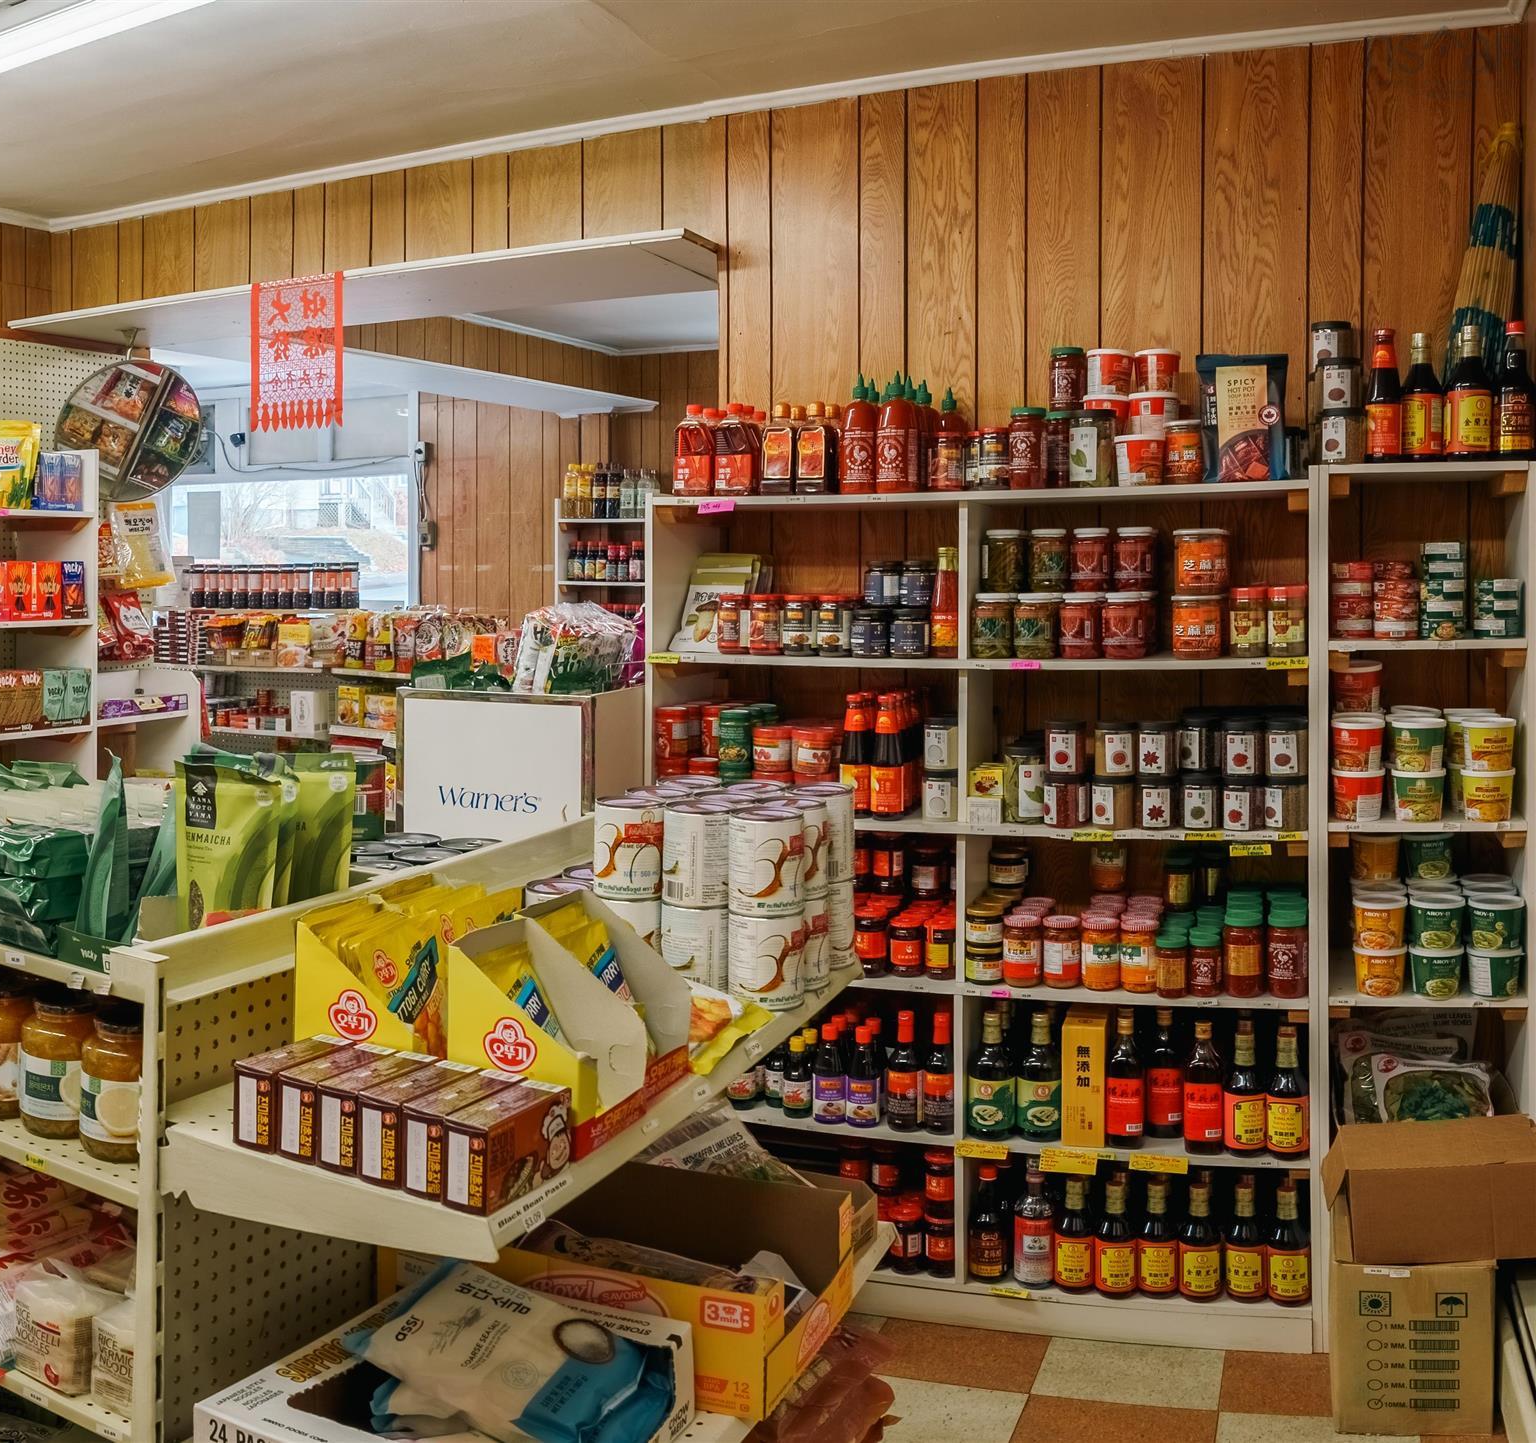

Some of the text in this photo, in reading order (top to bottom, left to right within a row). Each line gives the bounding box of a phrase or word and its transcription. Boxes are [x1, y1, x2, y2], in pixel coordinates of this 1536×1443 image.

[1227, 377, 1257, 387] SPICY
[189, 803, 212, 811] MOTO
[191, 796, 211, 804] YAMA
[438, 784, 538, 815] Warner's
[189, 811, 211, 819] YAMA
[186, 830, 231, 846] ENMAICHA
[337, 1012, 370, 1031] 오뚜기
[1432, 1012, 1448, 1020] LIME
[493, 1042, 528, 1062] 오뚜기
[1076, 1045, 1091, 1087] 無添加
[498, 1179, 568, 1229] Black Bean Paste
[524, 1210, 543, 1229] $3.09
[539, 1279, 595, 1300] Bowl
[603, 1289, 645, 1302] SAVORY
[16, 1304, 31, 1323] RICE
[706, 1304, 719, 1320] 3
[395, 1313, 420, 1343] assi
[627, 1324, 652, 1337] STORE
[1390, 1322, 1408, 1330] MM.
[98, 1333, 119, 1351] RICE
[1390, 1342, 1408, 1350] MM.
[276, 1338, 349, 1383] SAPPOR
[1390, 1362, 1408, 1370] MM.
[733, 1381, 750, 1393] 12
[1390, 1382, 1408, 1390] MM.
[668, 1400, 690, 1431] CHOW
[209, 1418, 227, 1443] 24
